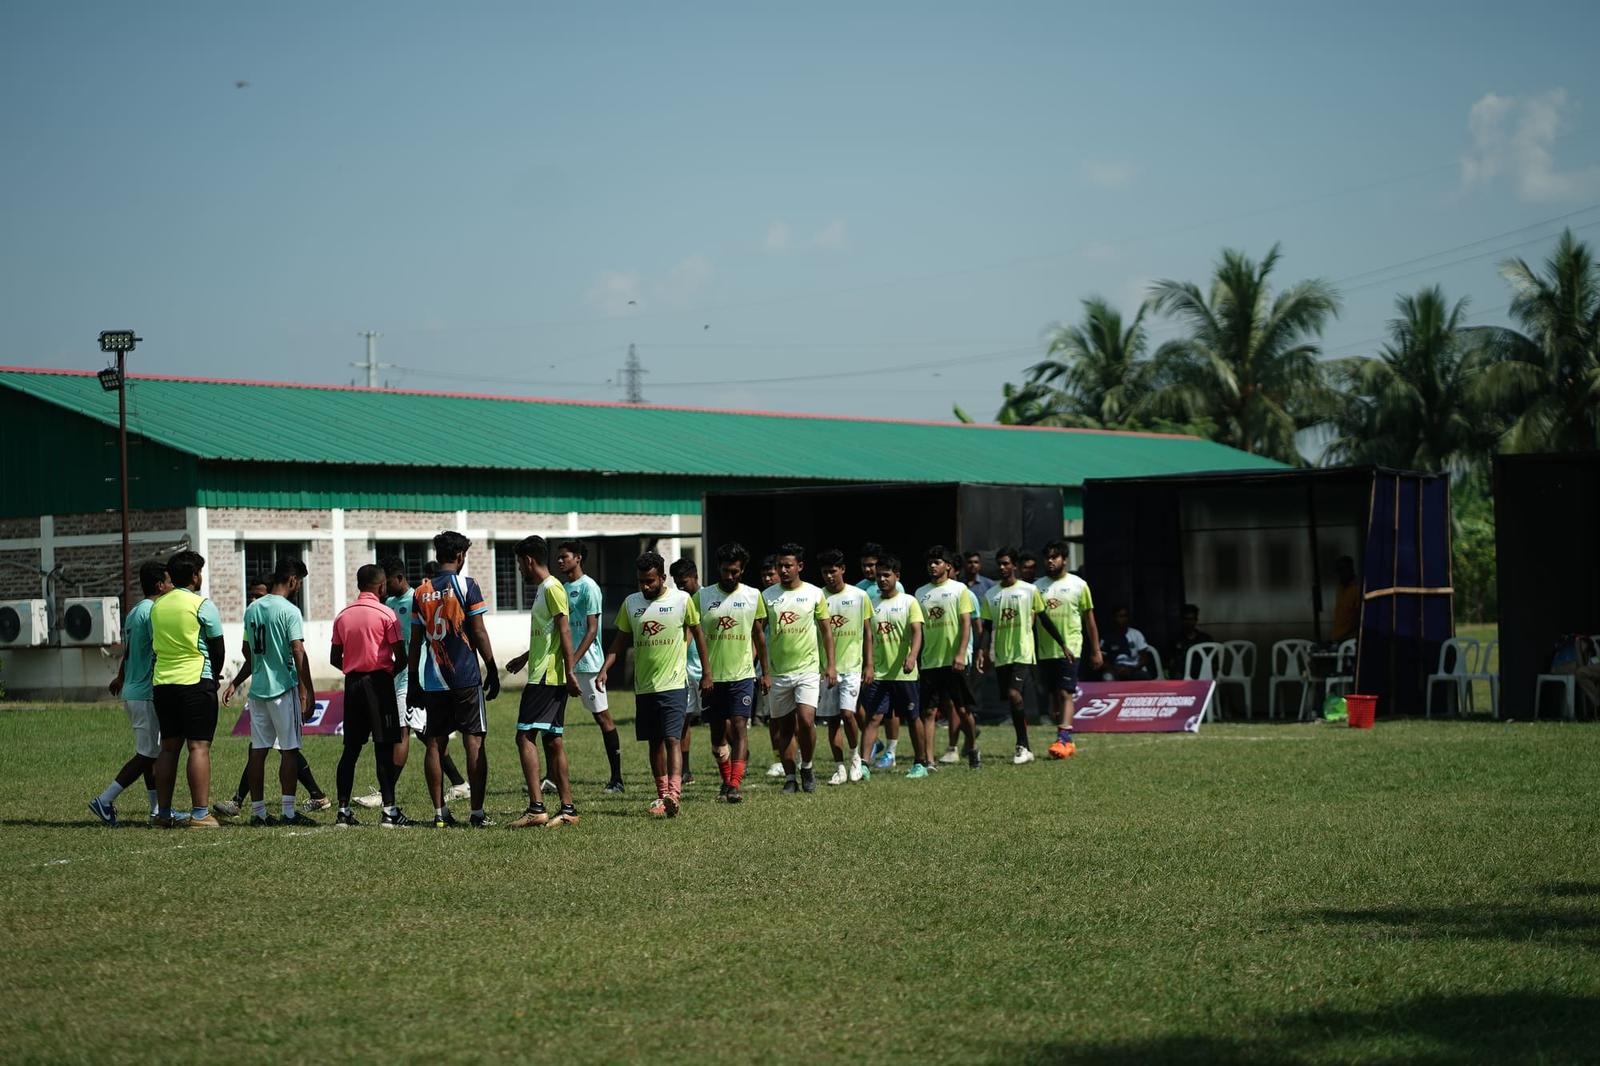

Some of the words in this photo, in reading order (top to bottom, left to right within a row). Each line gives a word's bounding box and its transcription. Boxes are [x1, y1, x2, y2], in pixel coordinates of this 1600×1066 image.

[433, 604, 447, 641] 6
[1122, 697, 1158, 707] STUDENT
[1118, 707, 1159, 717] MEMORIAL
[1158, 707, 1178, 717] CUP
